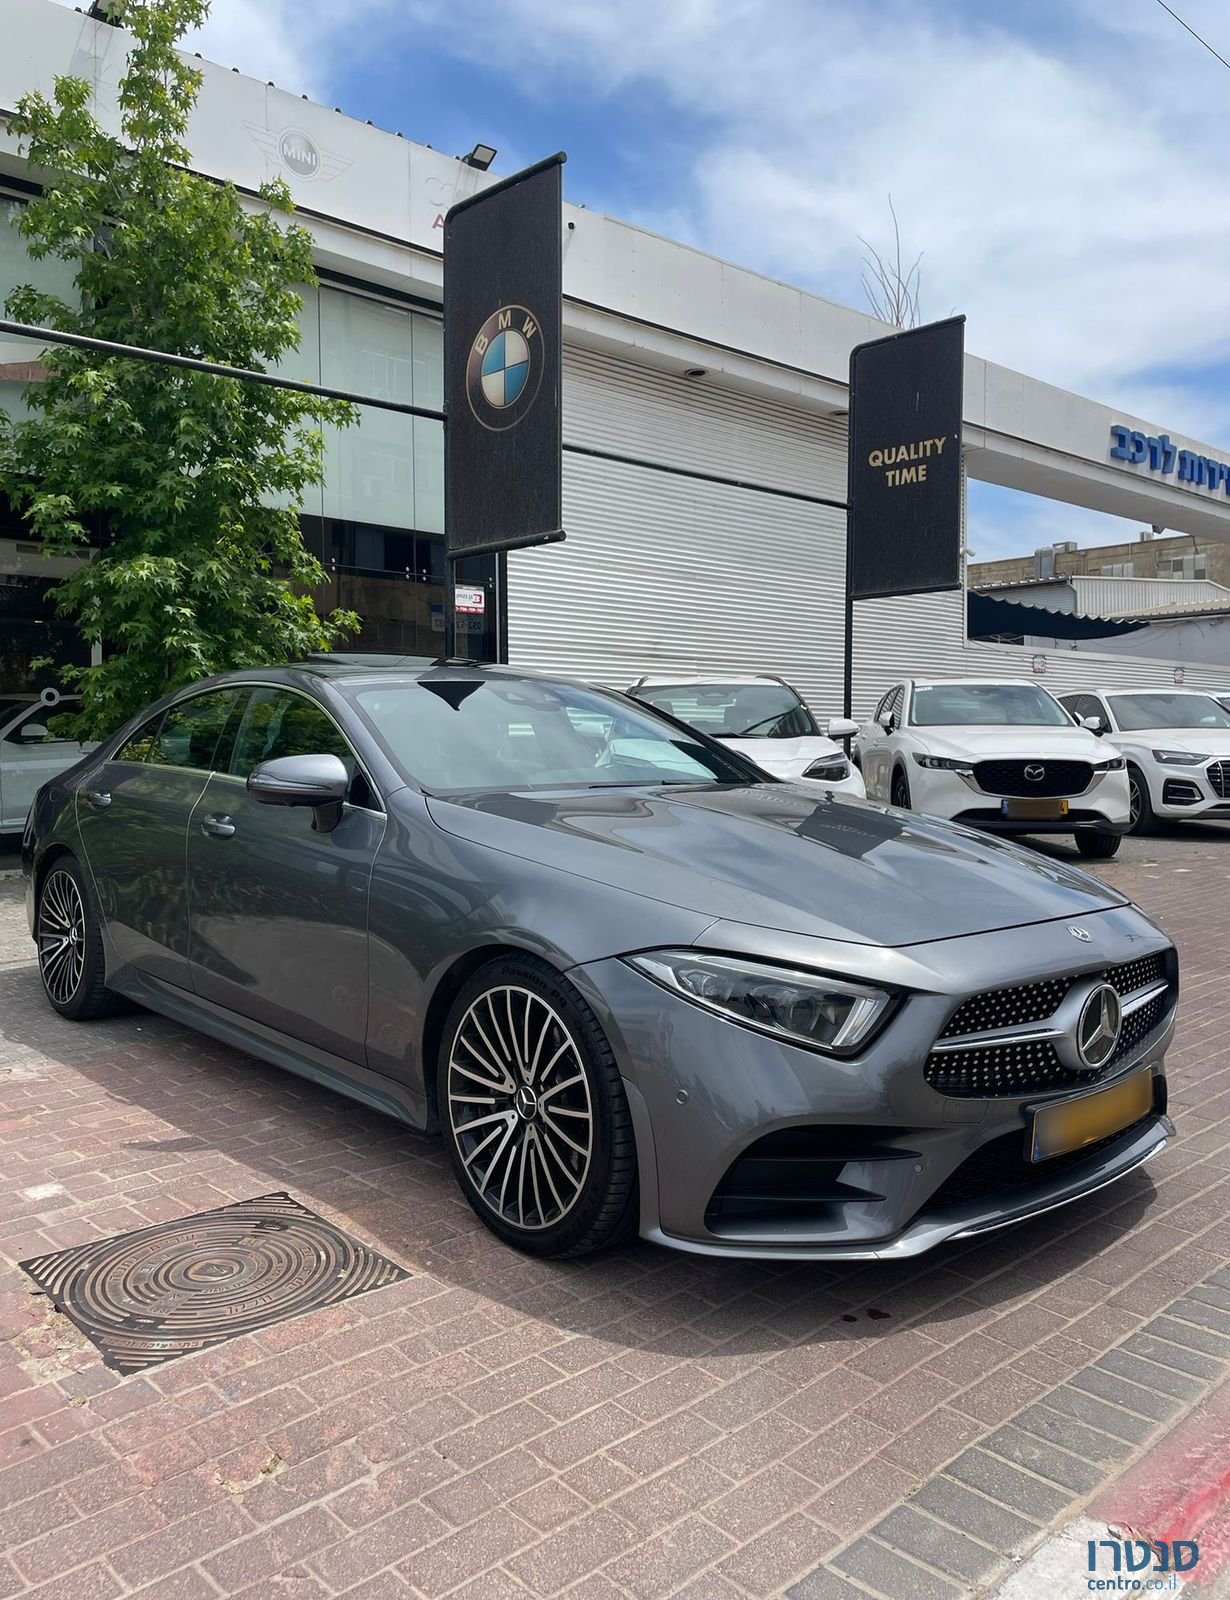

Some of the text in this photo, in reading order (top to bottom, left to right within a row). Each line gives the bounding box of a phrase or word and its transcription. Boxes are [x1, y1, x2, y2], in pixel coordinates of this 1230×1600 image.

[283, 143, 316, 167] MINI
[432, 213, 444, 229] A
[475, 310, 537, 355] BMW
[868, 436, 947, 468] QUALITY
[1110, 425, 1230, 496] ירות לרכב
[885, 464, 927, 487] TIME
